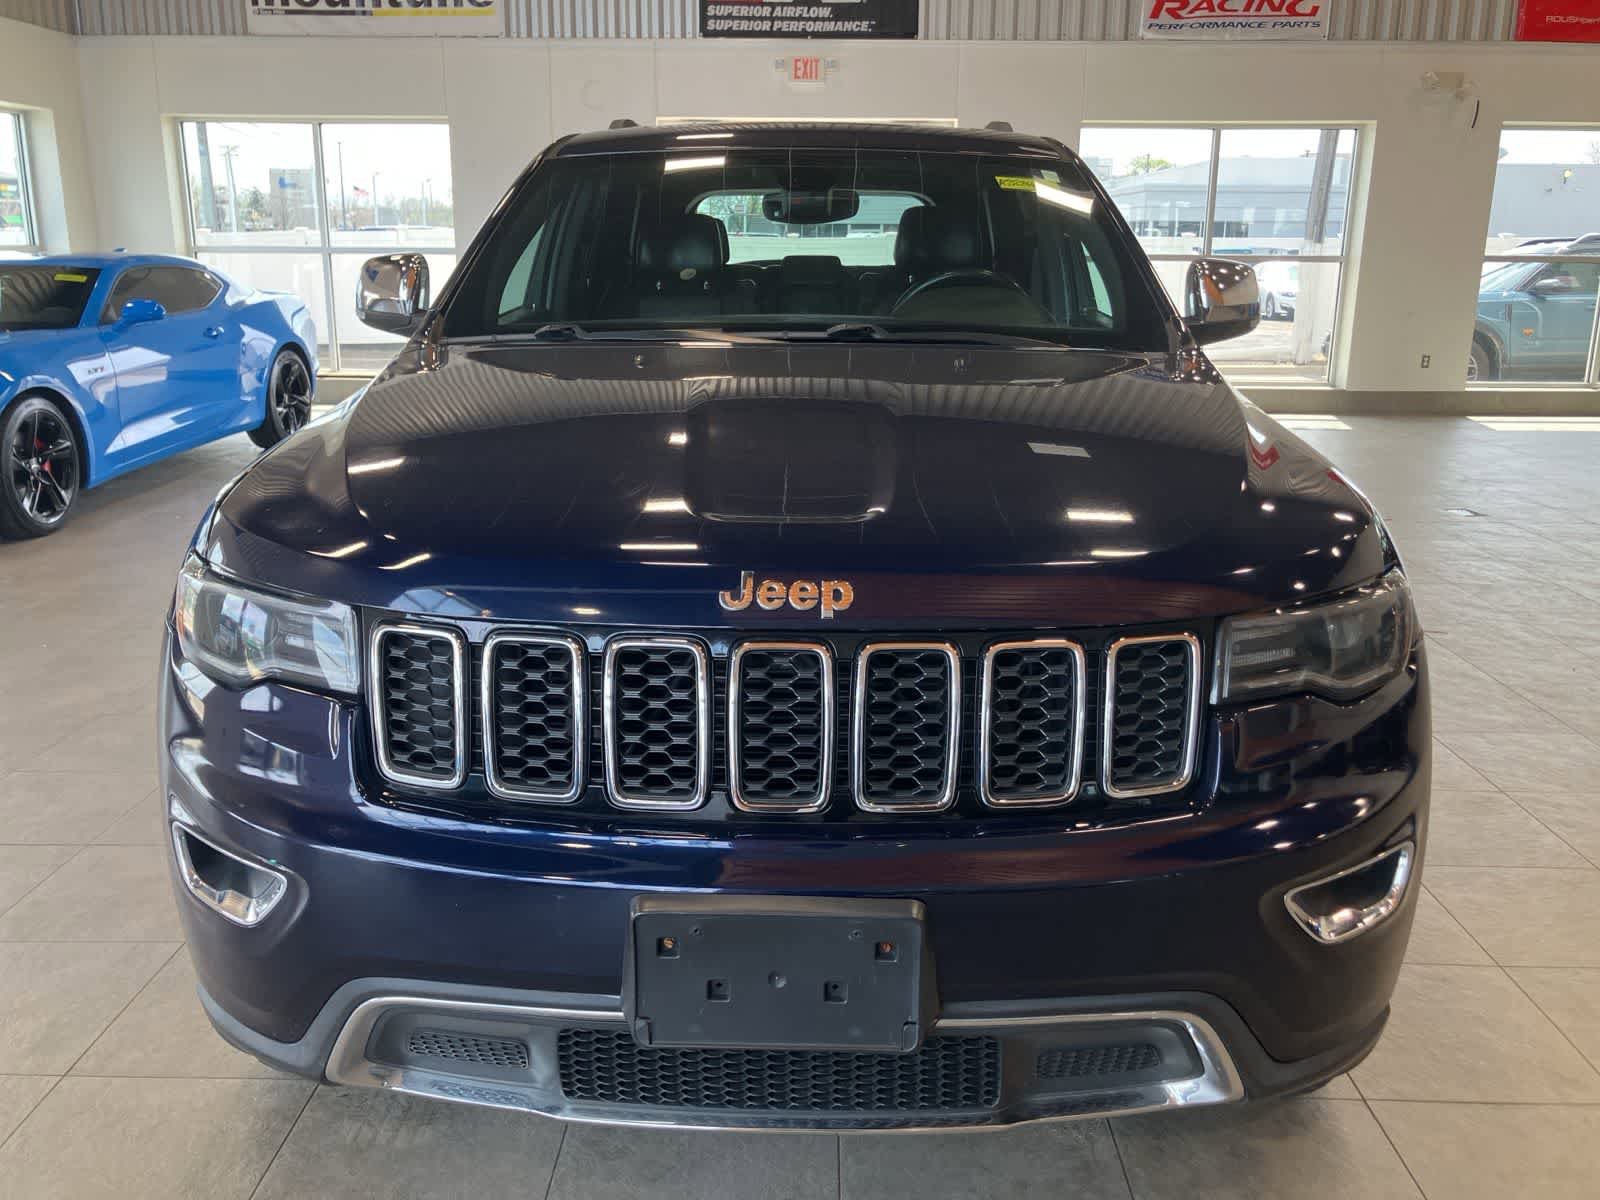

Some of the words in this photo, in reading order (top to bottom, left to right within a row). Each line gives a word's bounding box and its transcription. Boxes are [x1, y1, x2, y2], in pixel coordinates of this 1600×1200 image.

[707, 5, 772, 17] SUPERIOR
[773, 6, 833, 18] AIRFLOW.
[706, 19, 772, 31] SUPERIOR
[1147, 21, 1269, 30] PERFORMANCE
[1272, 21, 1321, 29] PARTS
[793, 56, 819, 80] EXIT
[718, 570, 854, 619] Jeep
